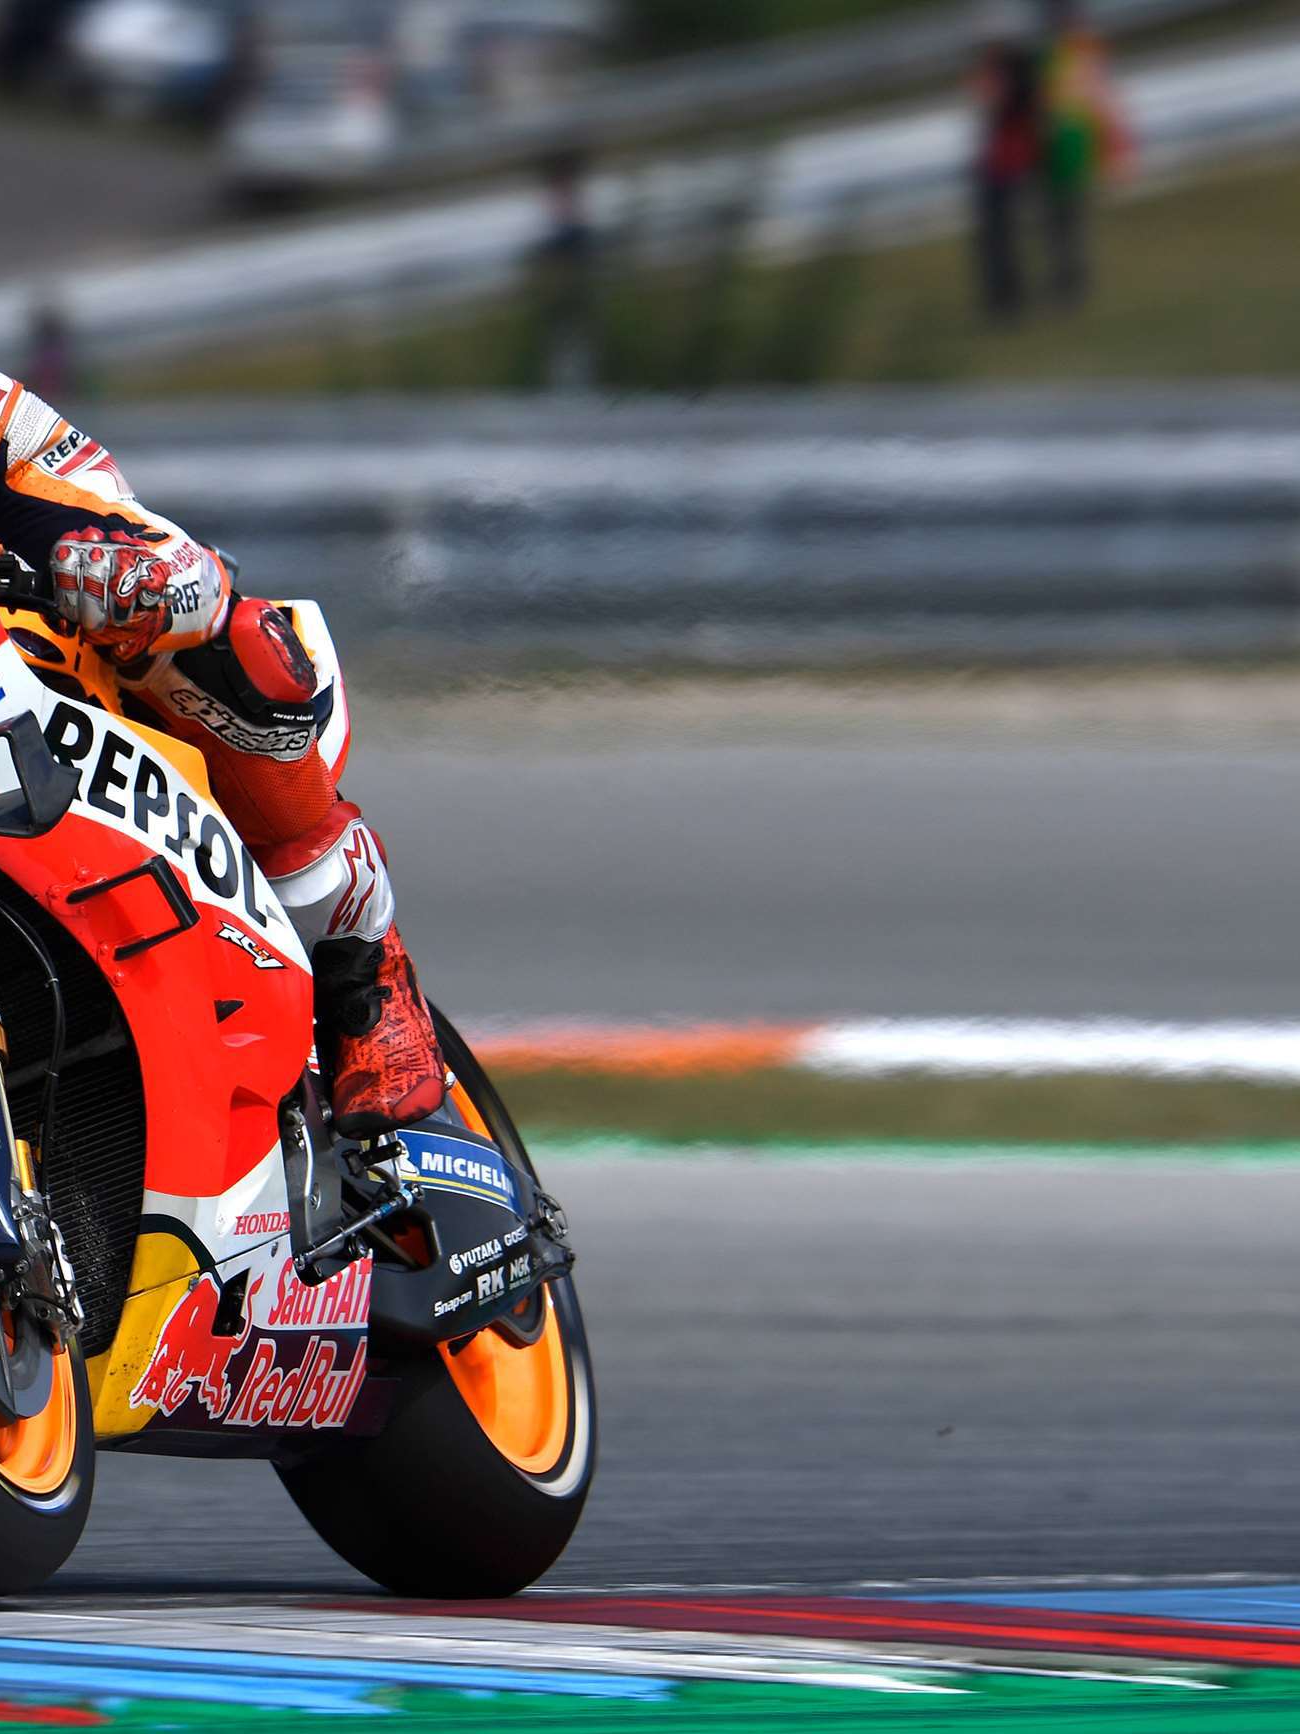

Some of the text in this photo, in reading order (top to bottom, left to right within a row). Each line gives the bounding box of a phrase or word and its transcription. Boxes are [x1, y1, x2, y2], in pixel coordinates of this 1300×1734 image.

[42, 701, 268, 928] REPSOL
[235, 1211, 290, 1236] HONDA
[460, 1238, 503, 1268] YUTAKA
[434, 1290, 473, 1317] Snap-on
[477, 1266, 505, 1300] RK
[509, 1254, 531, 1282] NGK
